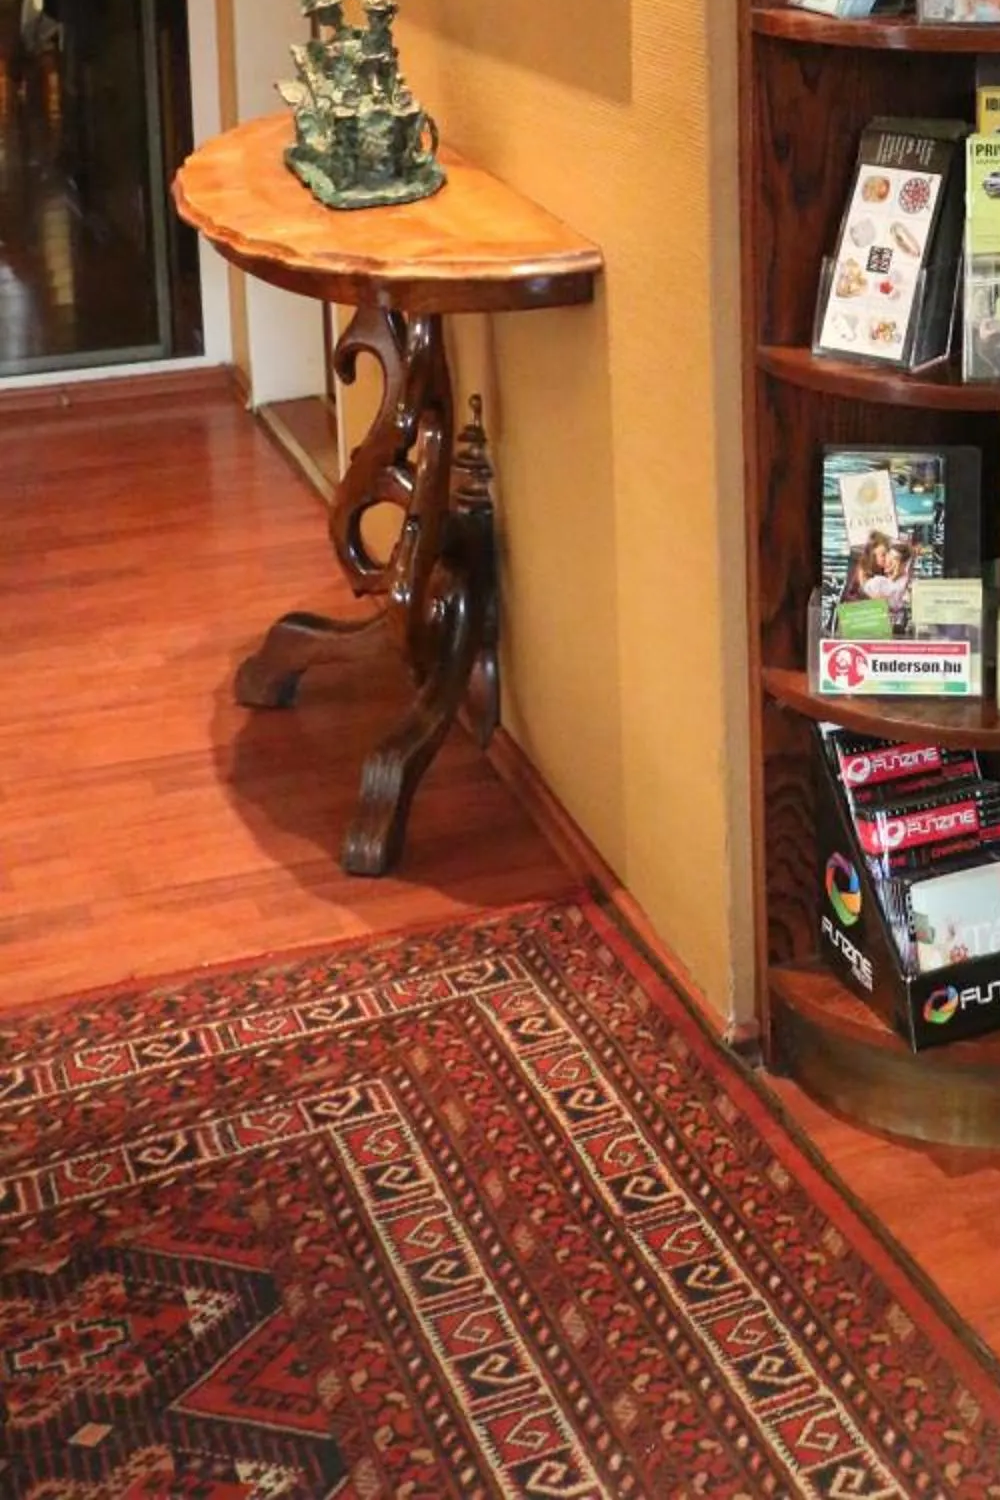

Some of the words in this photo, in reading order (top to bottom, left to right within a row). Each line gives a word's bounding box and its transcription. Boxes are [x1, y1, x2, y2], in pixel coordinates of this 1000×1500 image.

[871, 658, 963, 675] Enderson.hu
[872, 746, 938, 772] FUNZINE
[907, 809, 976, 837] FUNZINE
